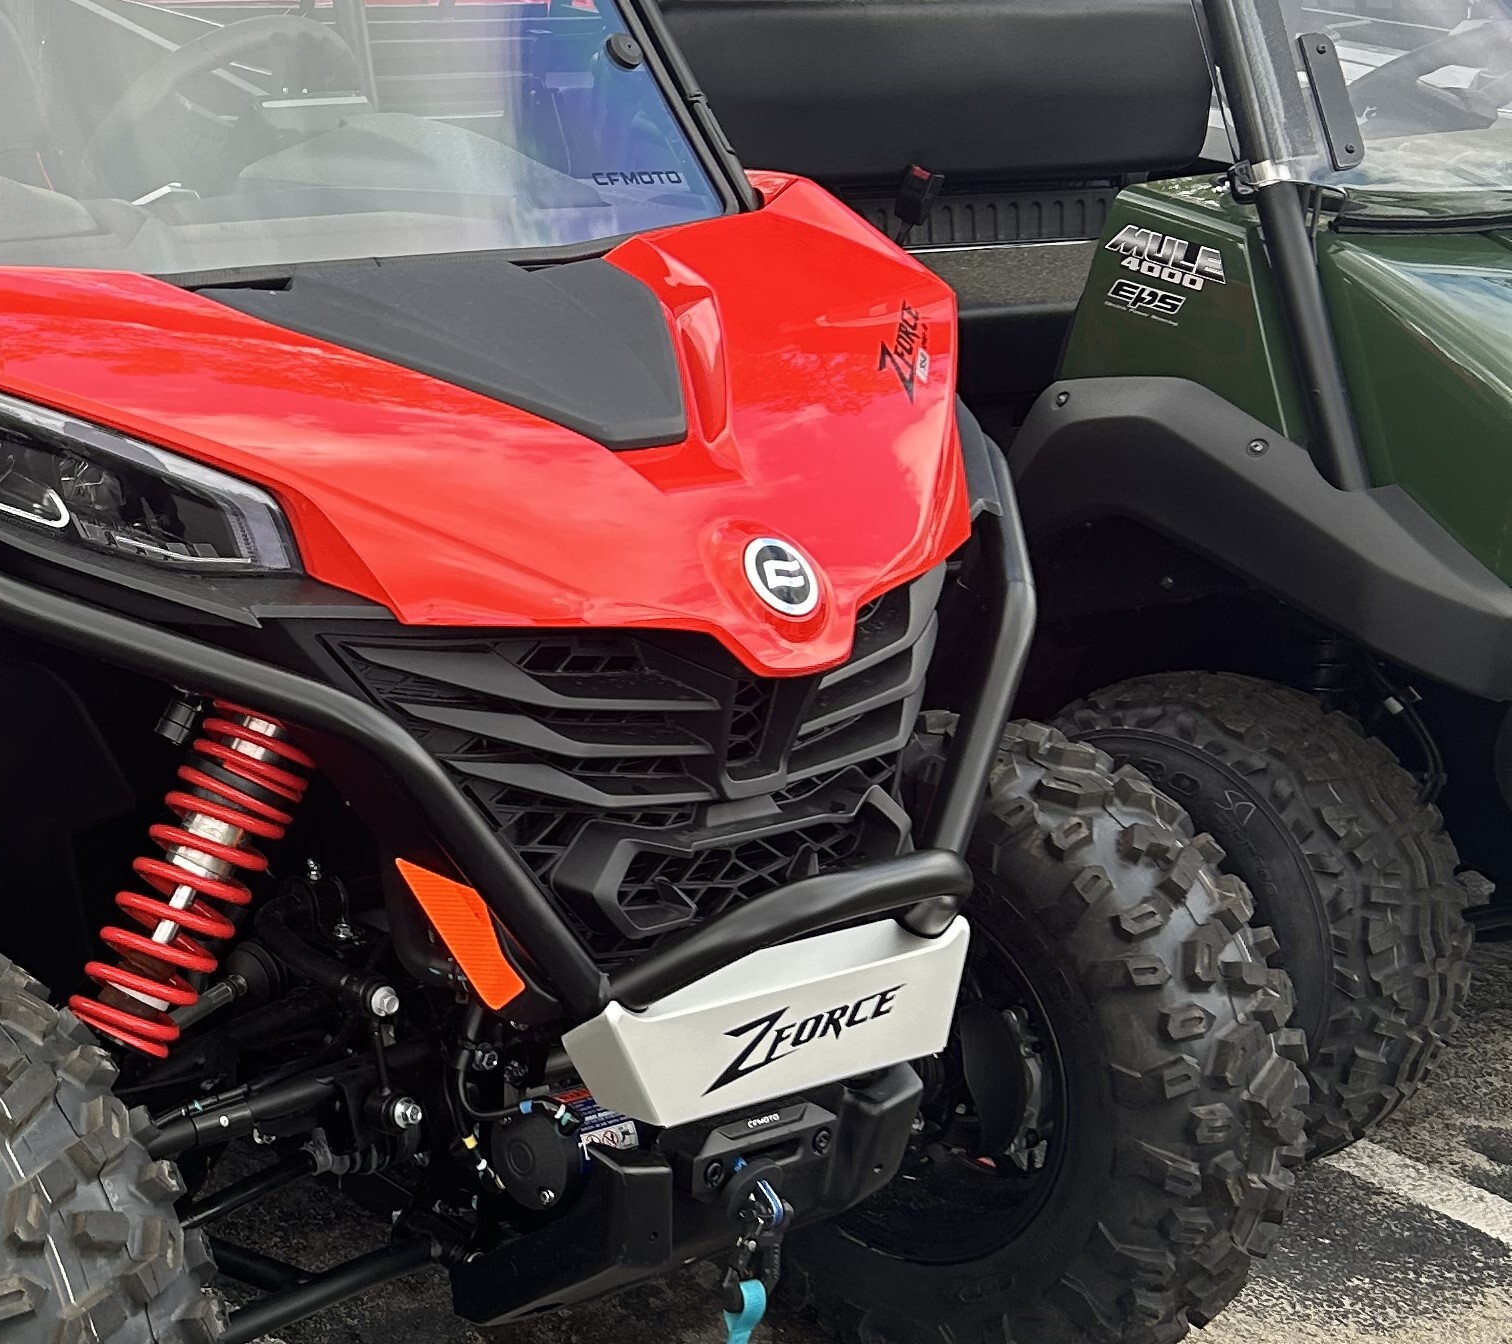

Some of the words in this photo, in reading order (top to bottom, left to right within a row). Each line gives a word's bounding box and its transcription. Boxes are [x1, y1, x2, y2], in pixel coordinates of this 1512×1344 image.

[591, 170, 683, 186] CFMOTO
[1105, 224, 1226, 284] MULE
[1121, 256, 1204, 291] 4000
[701, 983, 908, 1097] ZFORCE
[747, 1113, 780, 1129] CFMOTO
